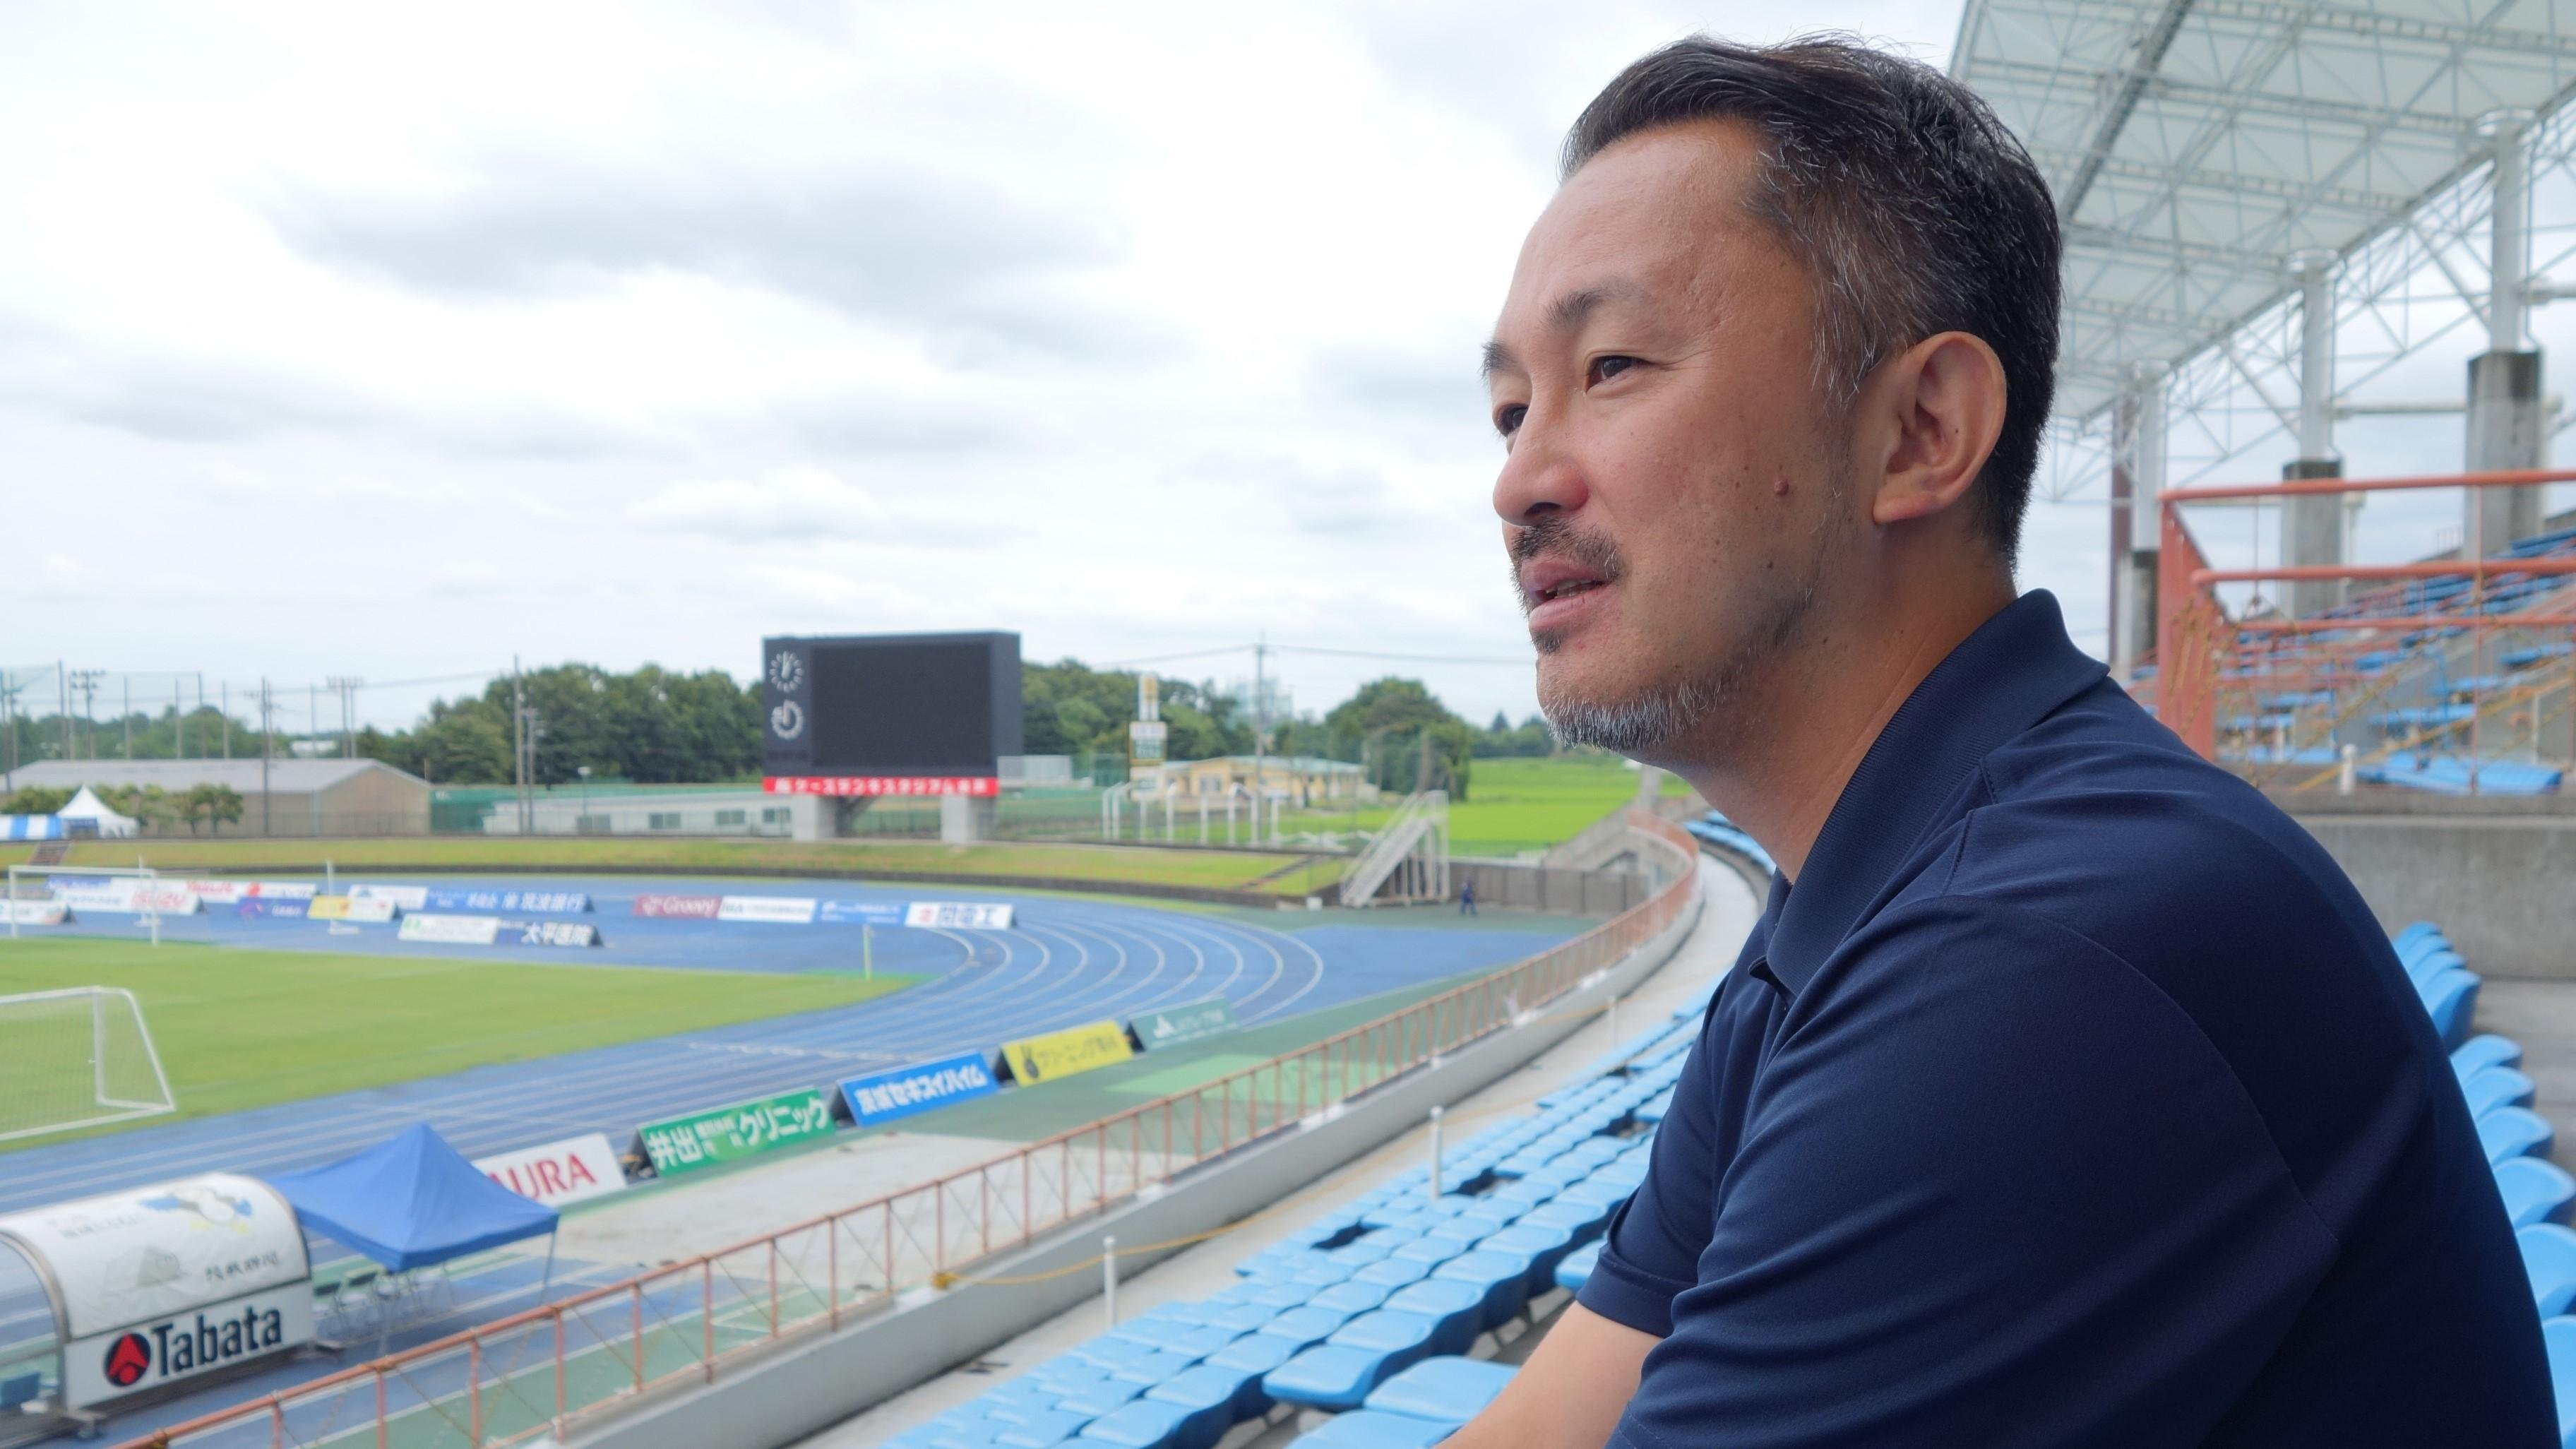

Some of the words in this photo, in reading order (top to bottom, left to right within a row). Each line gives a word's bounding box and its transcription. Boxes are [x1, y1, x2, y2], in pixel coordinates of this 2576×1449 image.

[648, 1124, 705, 1170] 井出
[739, 1097, 830, 1147] クリニック
[152, 1306, 282, 1376] Tabata
